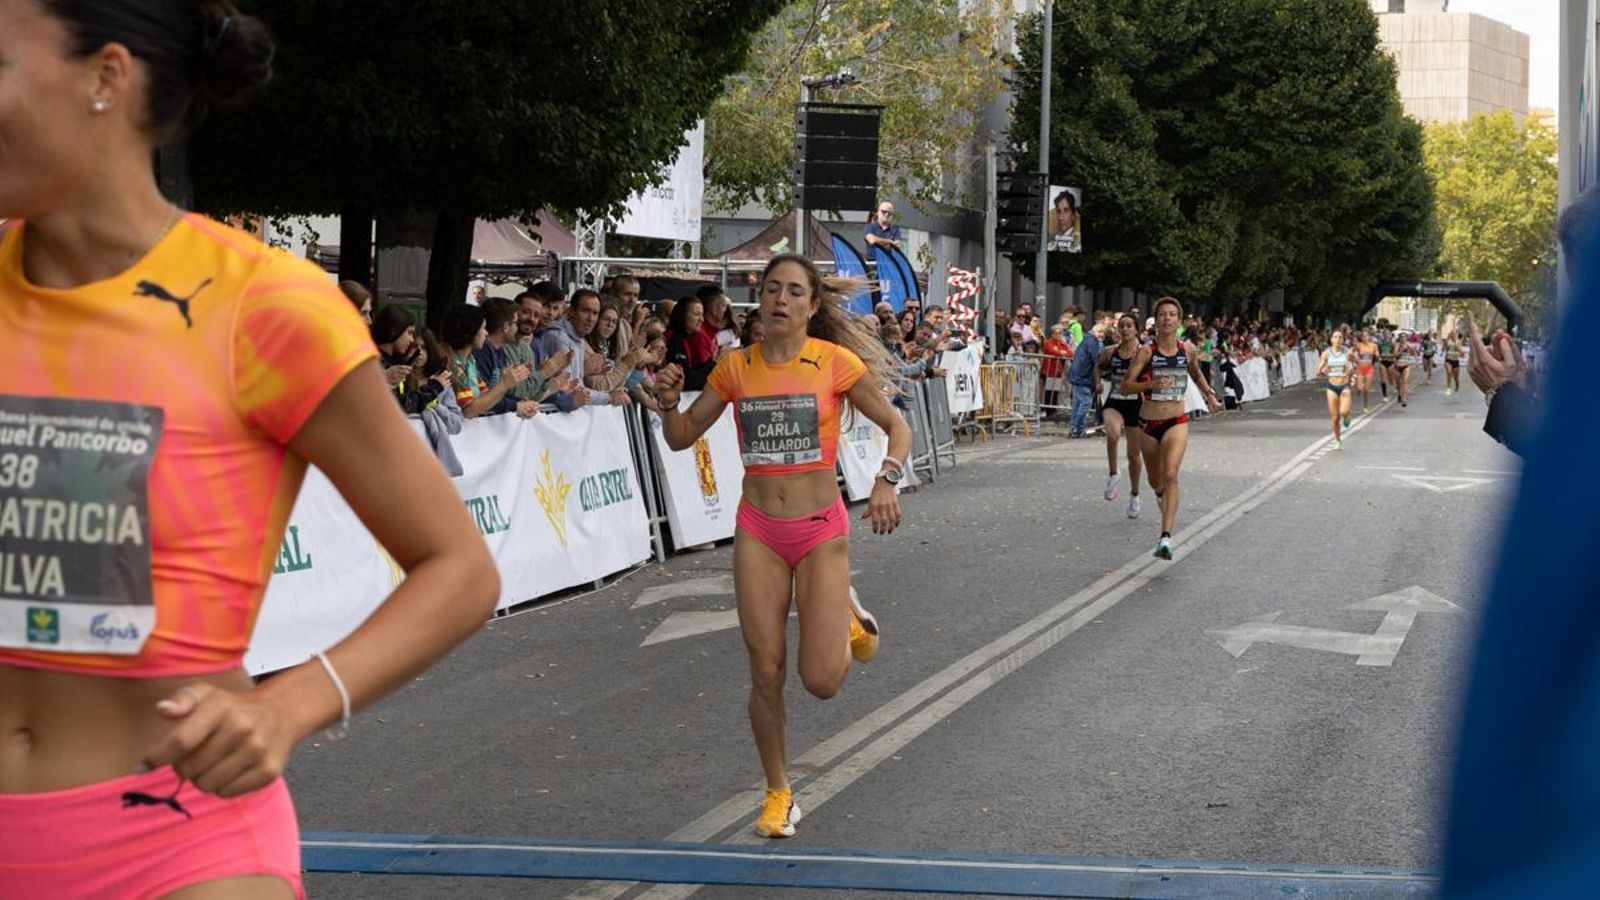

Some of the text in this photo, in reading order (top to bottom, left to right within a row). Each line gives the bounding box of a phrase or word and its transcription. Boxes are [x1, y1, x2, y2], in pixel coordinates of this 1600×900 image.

[740, 401, 754, 413] 36
[39, 425, 149, 455] Pancorbo
[757, 422, 801, 438] CARLA
[0, 453, 39, 489] 38
[0, 497, 144, 546] ATRICIA
